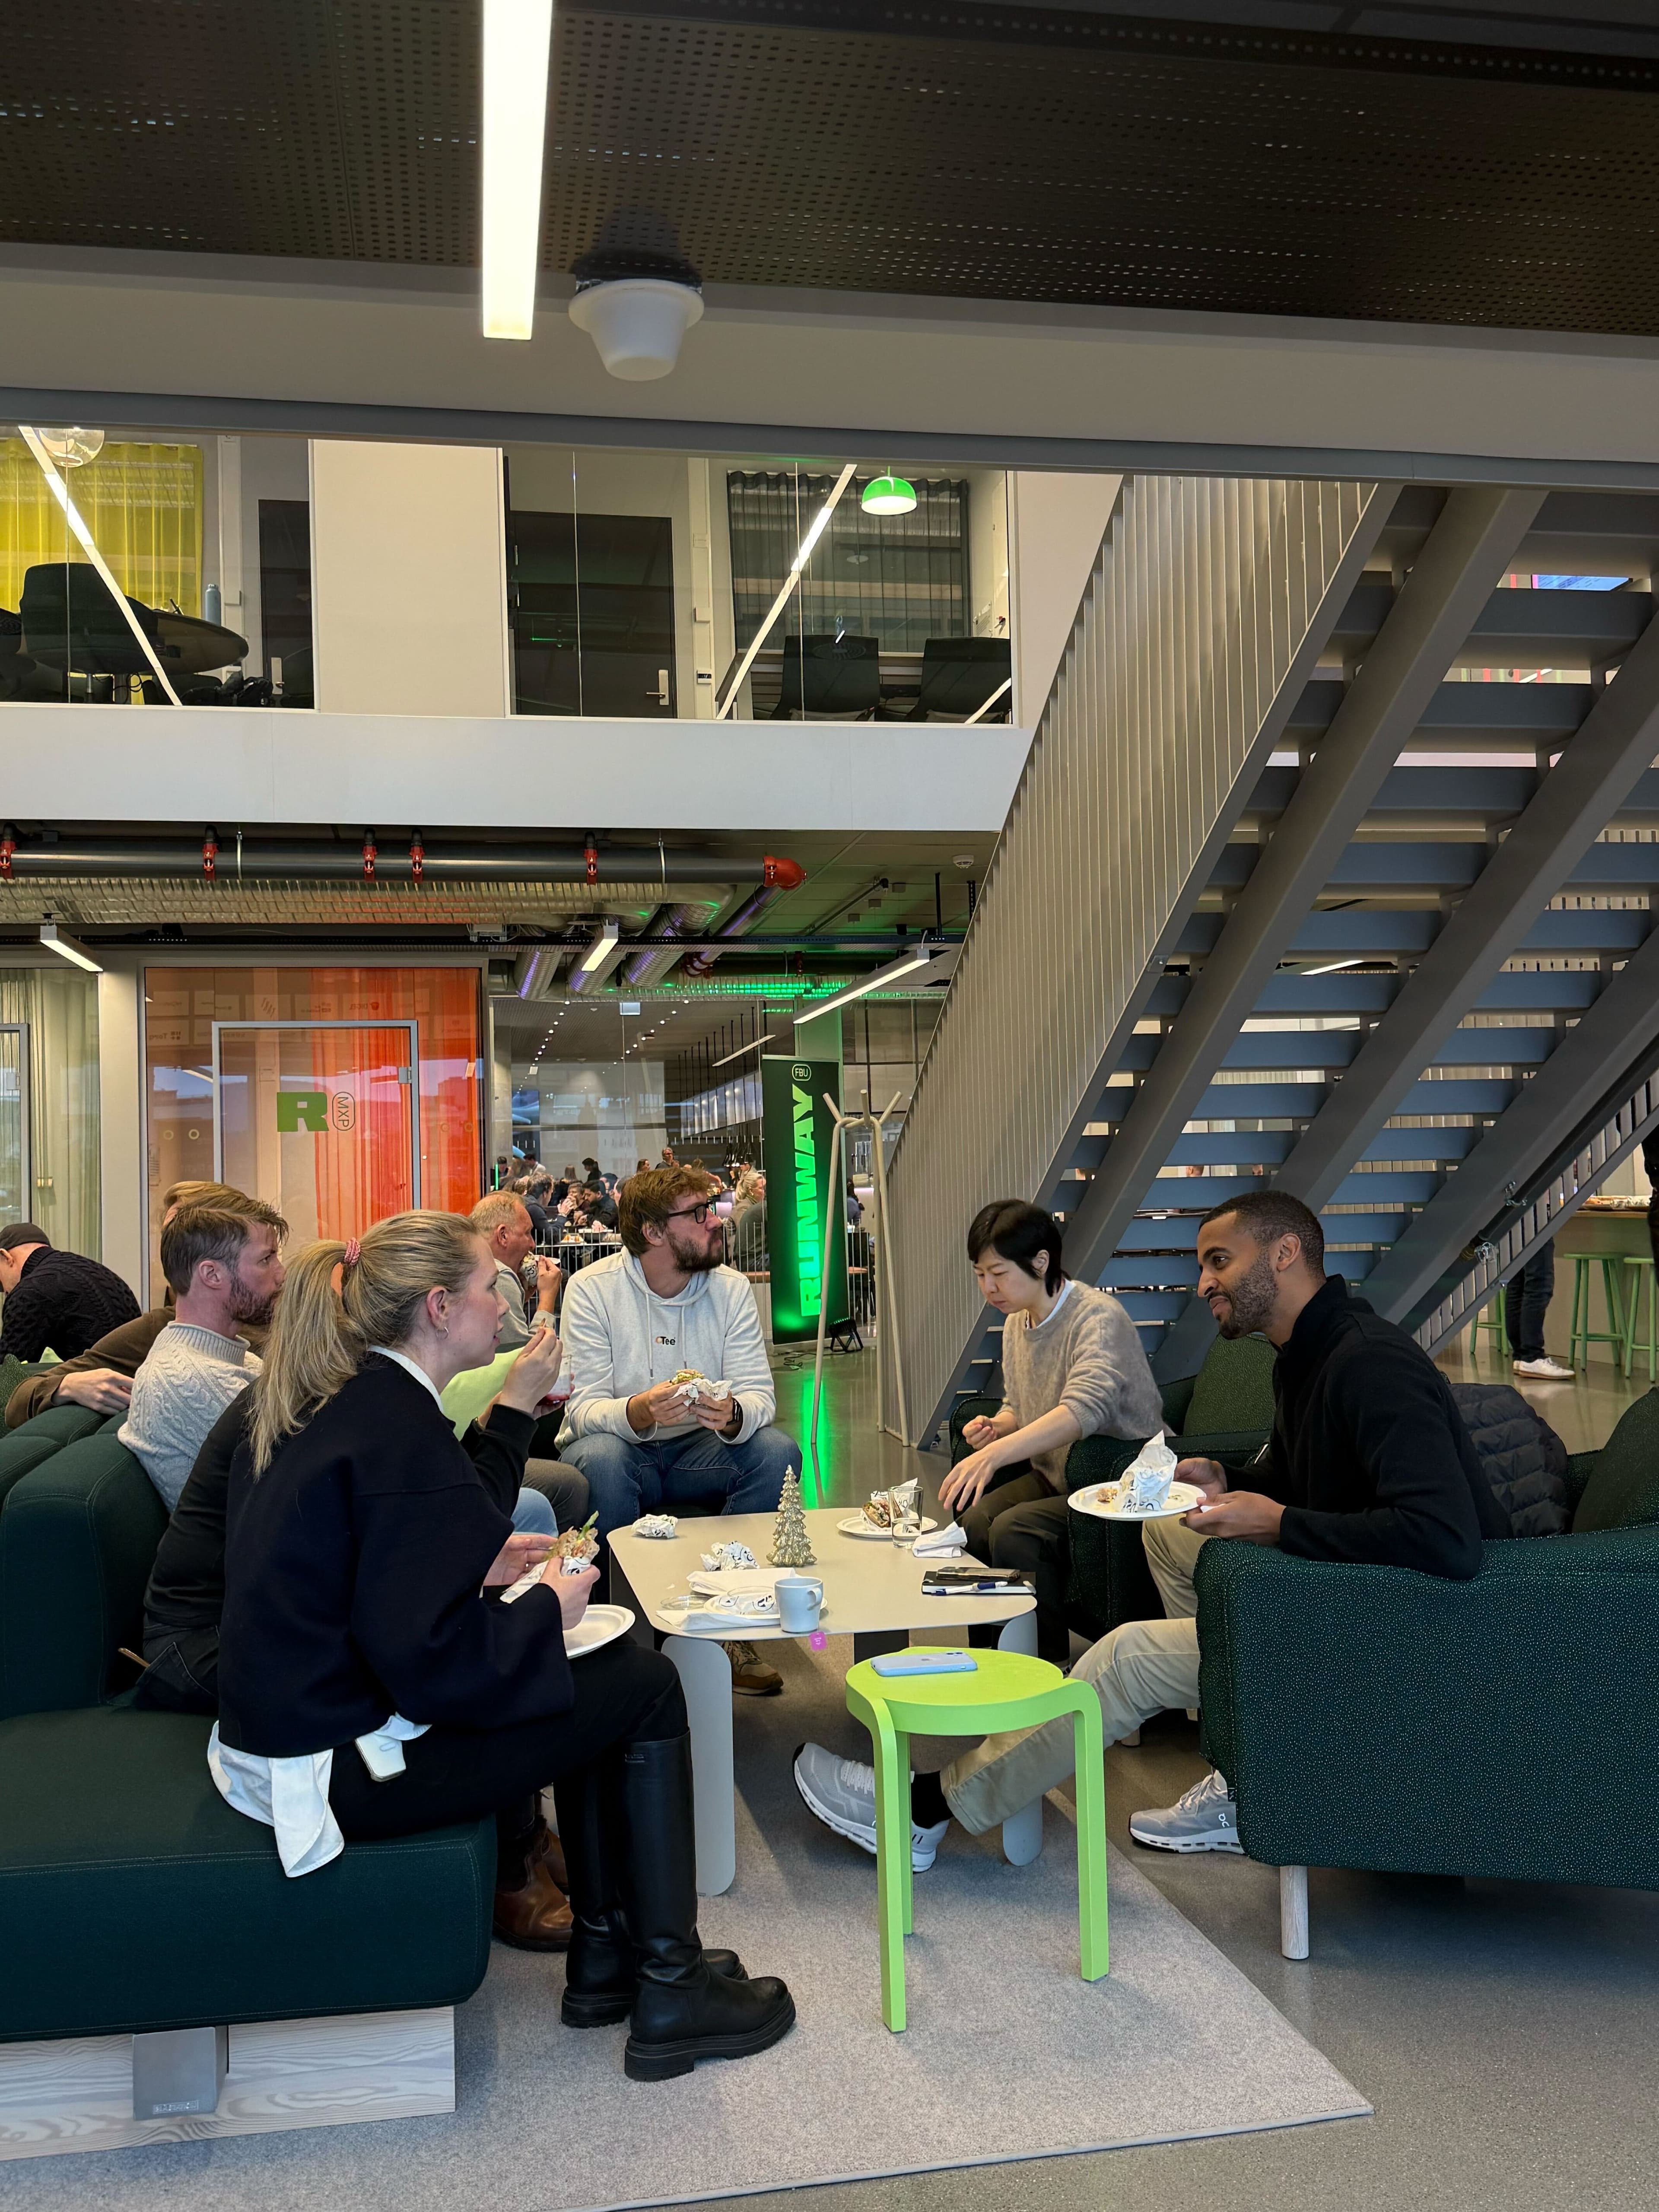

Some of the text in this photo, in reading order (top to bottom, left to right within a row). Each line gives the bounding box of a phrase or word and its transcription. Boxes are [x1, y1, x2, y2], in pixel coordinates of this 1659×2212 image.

[795, 1068, 808, 1077] FBU
[276, 1092, 329, 1132] R
[337, 1096, 350, 1128] MXP
[792, 1083, 822, 1317] RUNWAY
